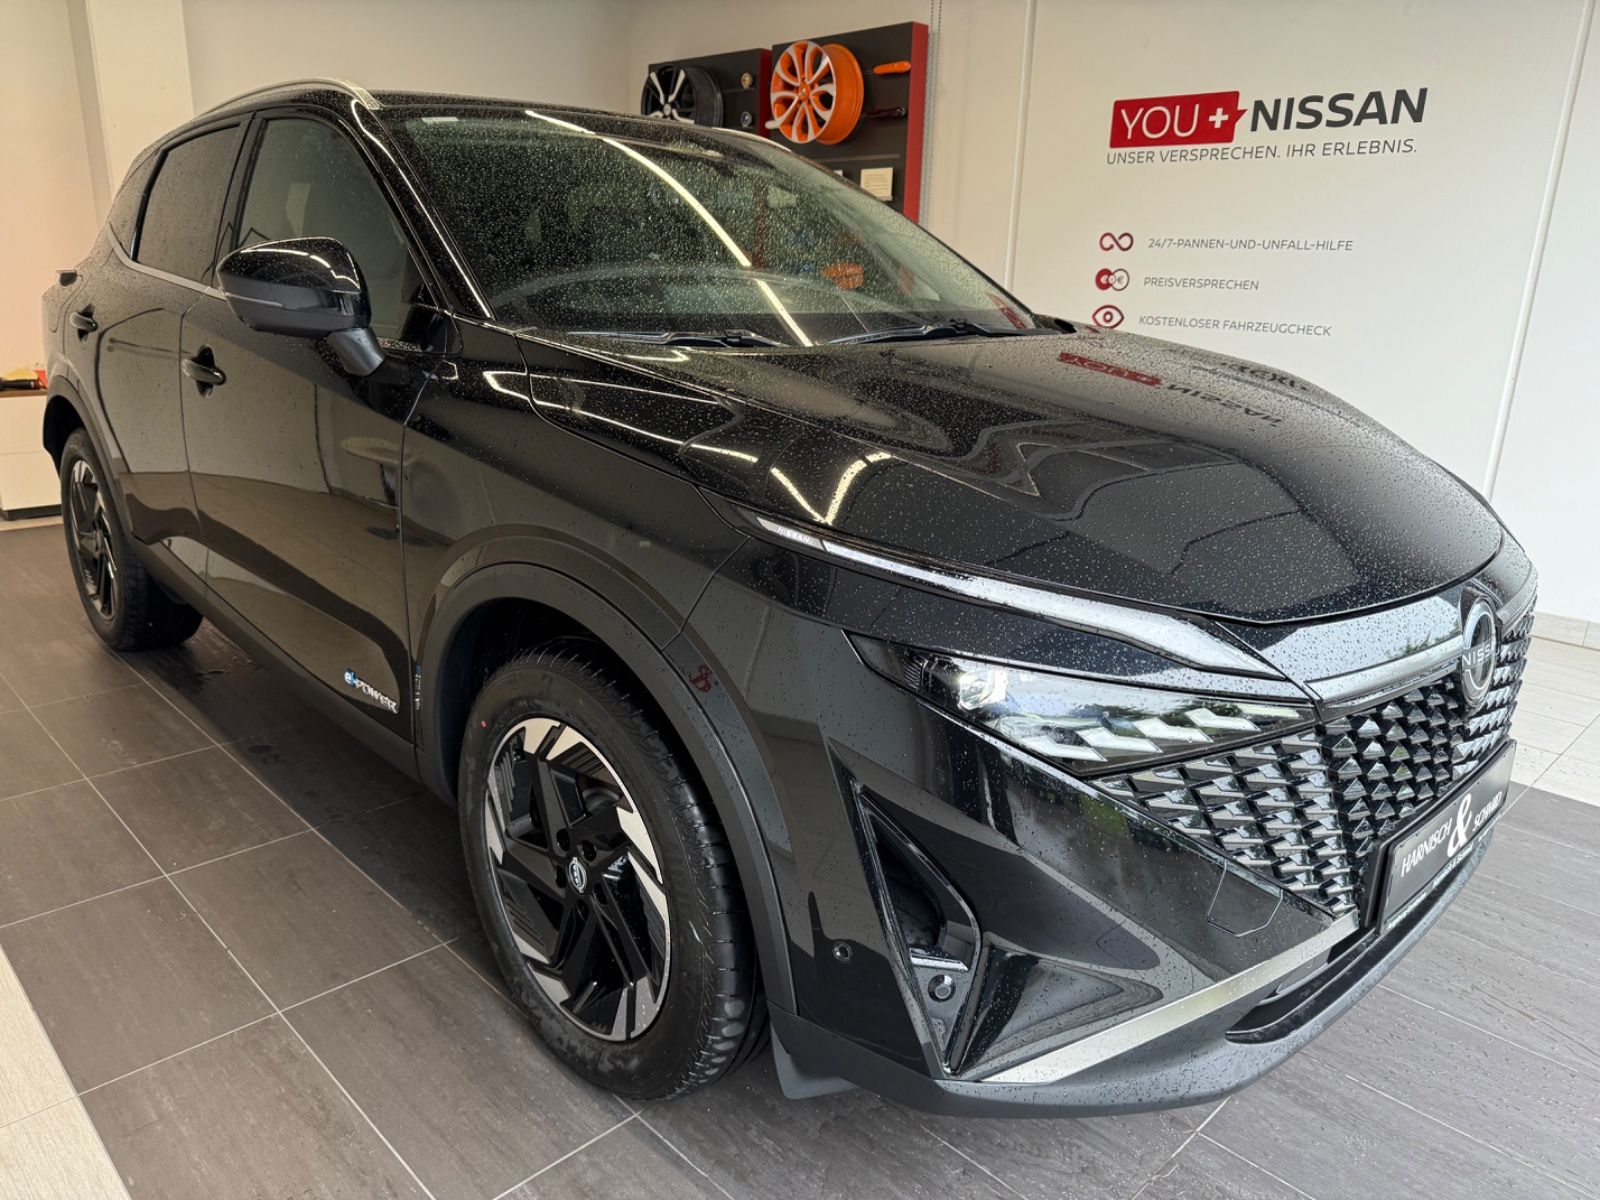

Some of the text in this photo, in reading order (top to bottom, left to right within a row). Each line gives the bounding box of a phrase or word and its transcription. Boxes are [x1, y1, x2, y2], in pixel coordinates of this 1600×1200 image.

[1250, 87, 1428, 132] NISSAN
[1106, 138, 1417, 165] UNSER VERSPRECHEN. IHR ERLEBNIS.
[1143, 276, 1259, 291] PREISVERSPRECHEN
[1138, 315, 1332, 337] KOSTENLOSER FAHRZEUGCHECK
[1447, 793, 1473, 858] &
